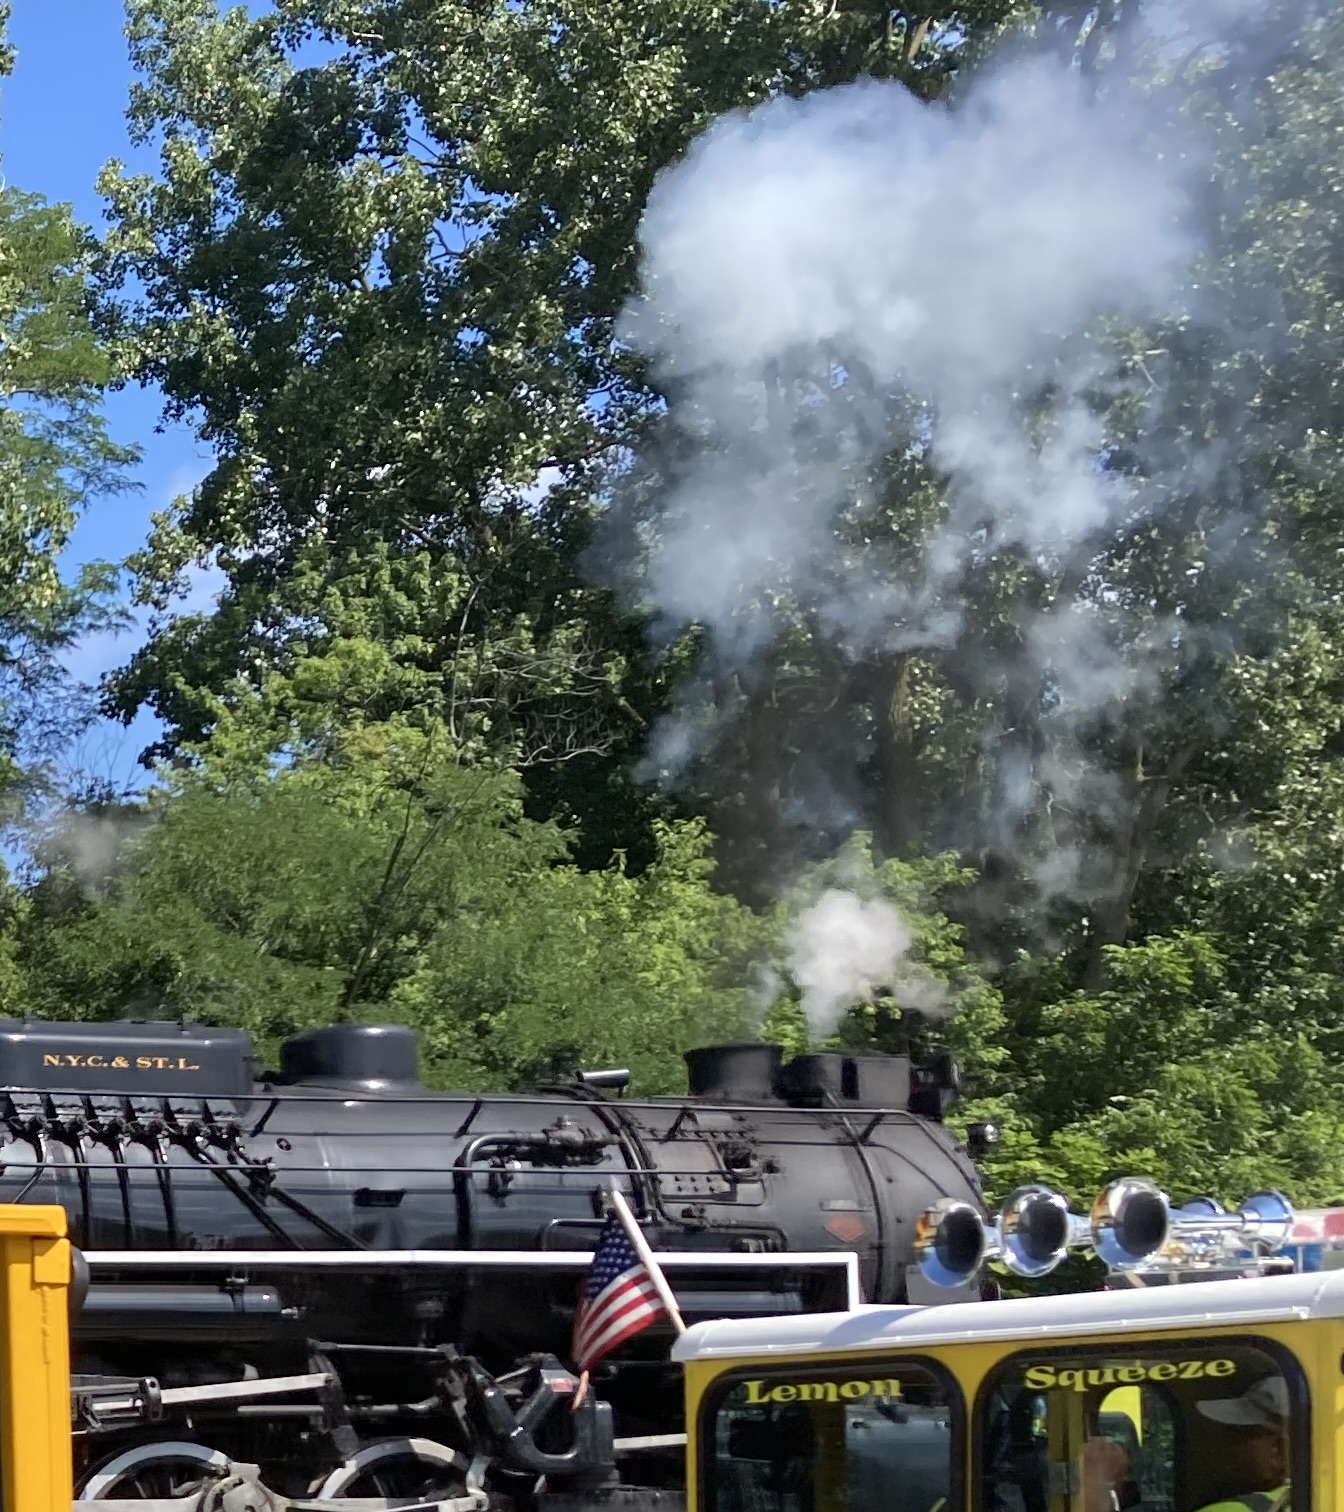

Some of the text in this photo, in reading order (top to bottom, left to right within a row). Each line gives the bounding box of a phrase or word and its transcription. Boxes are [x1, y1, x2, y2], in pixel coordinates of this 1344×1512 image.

[111, 1056, 129, 1068] &
[1025, 1359, 1237, 1392] Squeeze
[742, 1379, 904, 1404] Lemon
